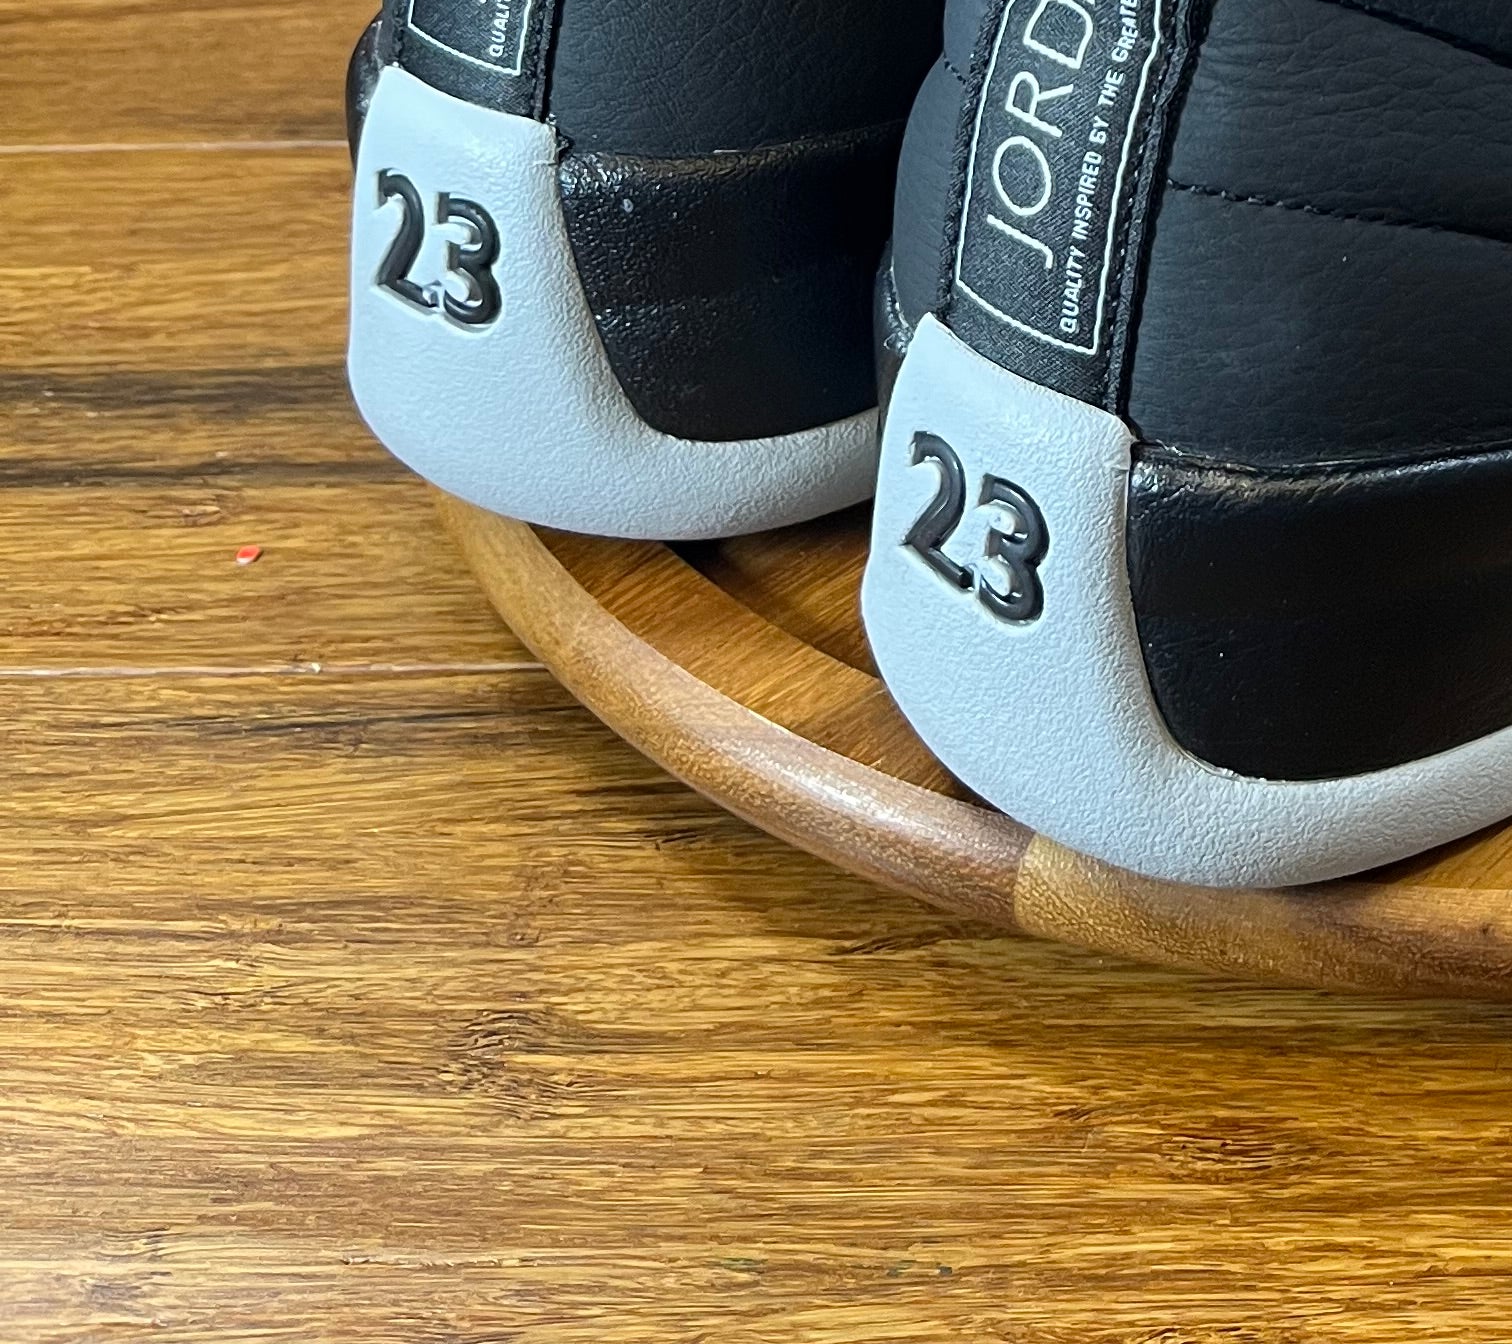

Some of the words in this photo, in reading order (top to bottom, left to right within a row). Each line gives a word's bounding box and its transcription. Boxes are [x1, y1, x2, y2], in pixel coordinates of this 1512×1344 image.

[1088, 115, 1110, 145] BY
[1098, 69, 1125, 106] THE
[1071, 151, 1102, 241] INSPIRED
[376, 167, 502, 327] 23
[1059, 245, 1086, 333] QUALITY
[901, 429, 1051, 626] 23
